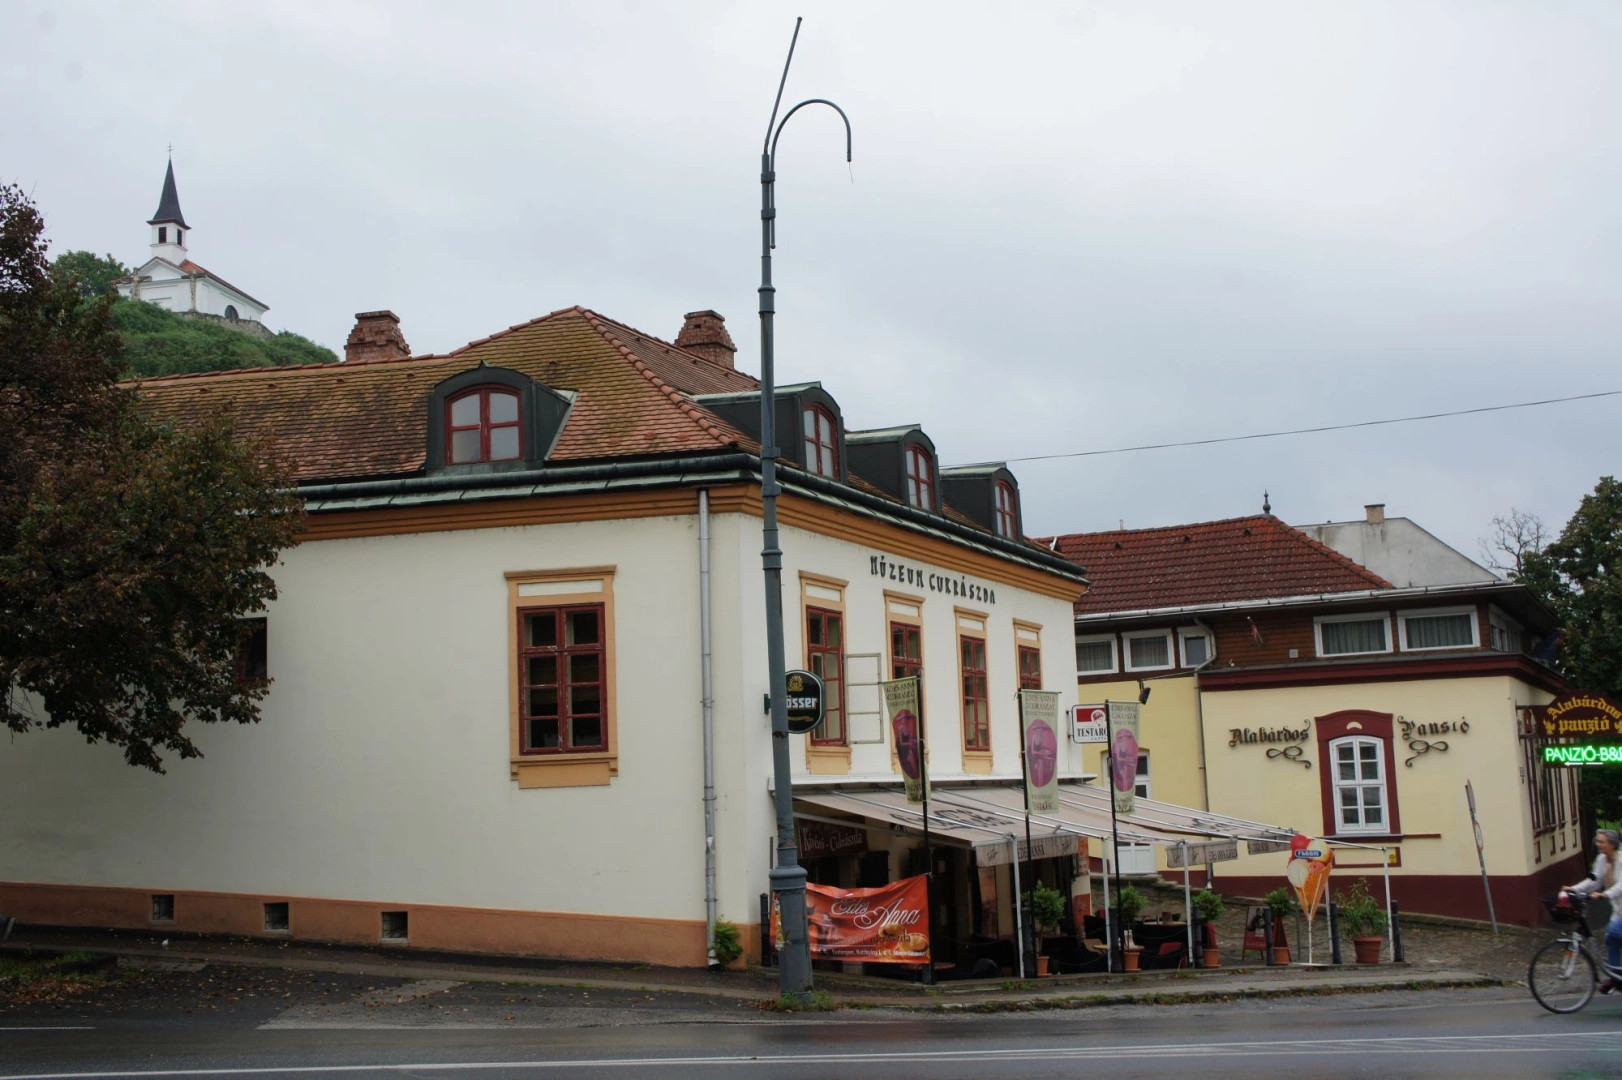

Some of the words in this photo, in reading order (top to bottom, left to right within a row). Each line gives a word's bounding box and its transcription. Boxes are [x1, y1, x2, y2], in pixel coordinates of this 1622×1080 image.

[870, 555, 924, 588] MÚZEUM
[928, 575, 996, 604] CUKRÁSZDA
[786, 695, 818, 709] össer
[1547, 694, 1622, 720] Alabárdos
[1228, 720, 1310, 747] Alabárdos
[1558, 715, 1610, 735] panzió
[853, 898, 921, 929] Anna
